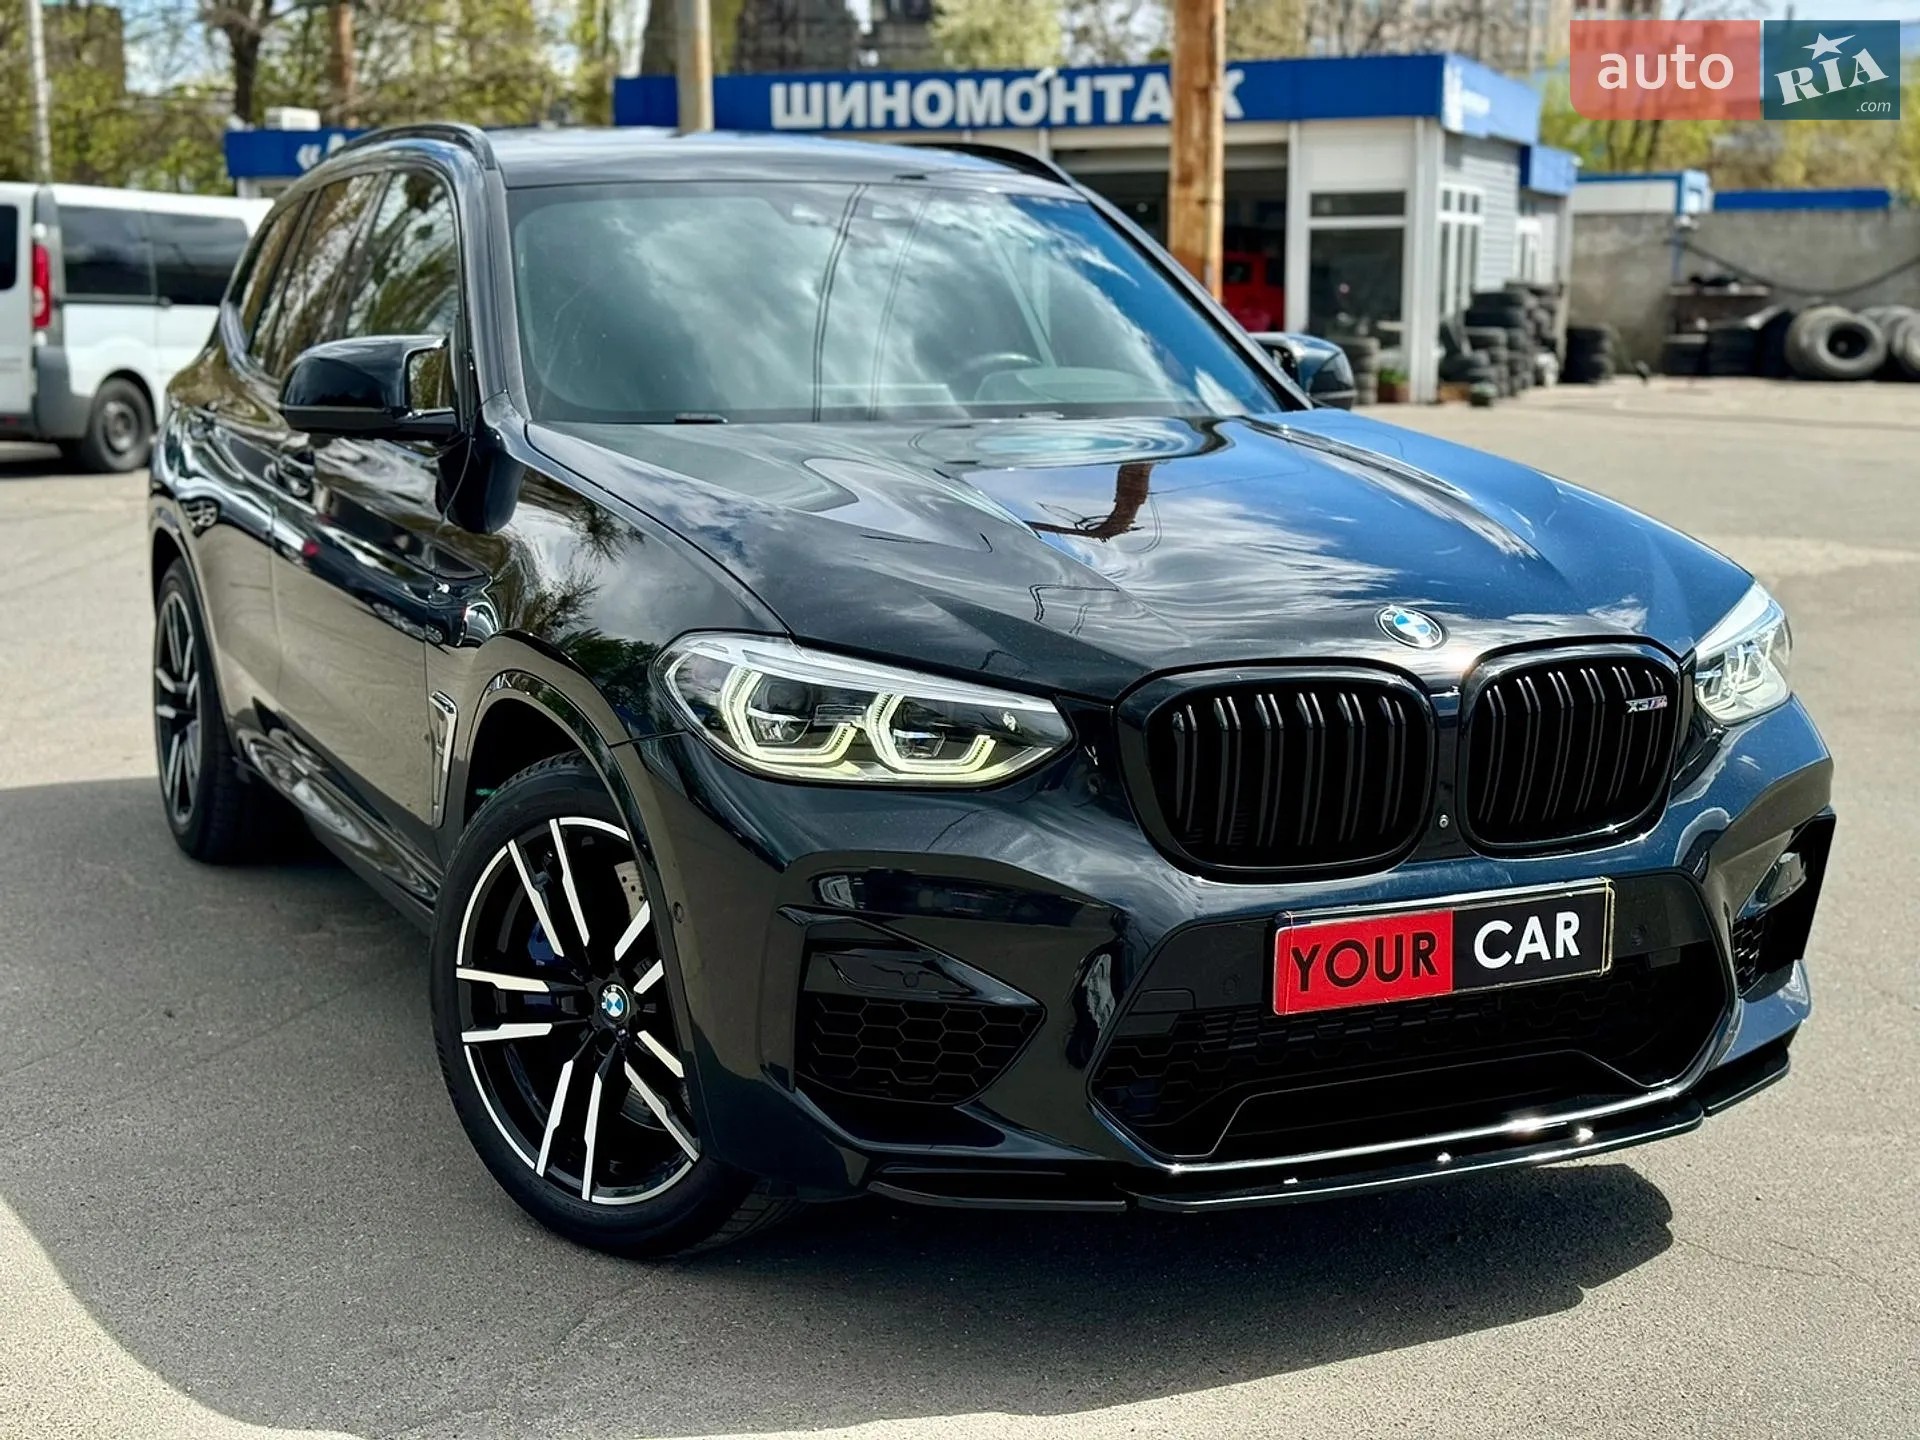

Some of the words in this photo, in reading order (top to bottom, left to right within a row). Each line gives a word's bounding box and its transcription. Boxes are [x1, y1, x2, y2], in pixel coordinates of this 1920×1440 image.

[769, 69, 1246, 130] ШИНОМОНТА
[1291, 931, 1439, 992] YOUR
[1473, 911, 1581, 970] CAR
